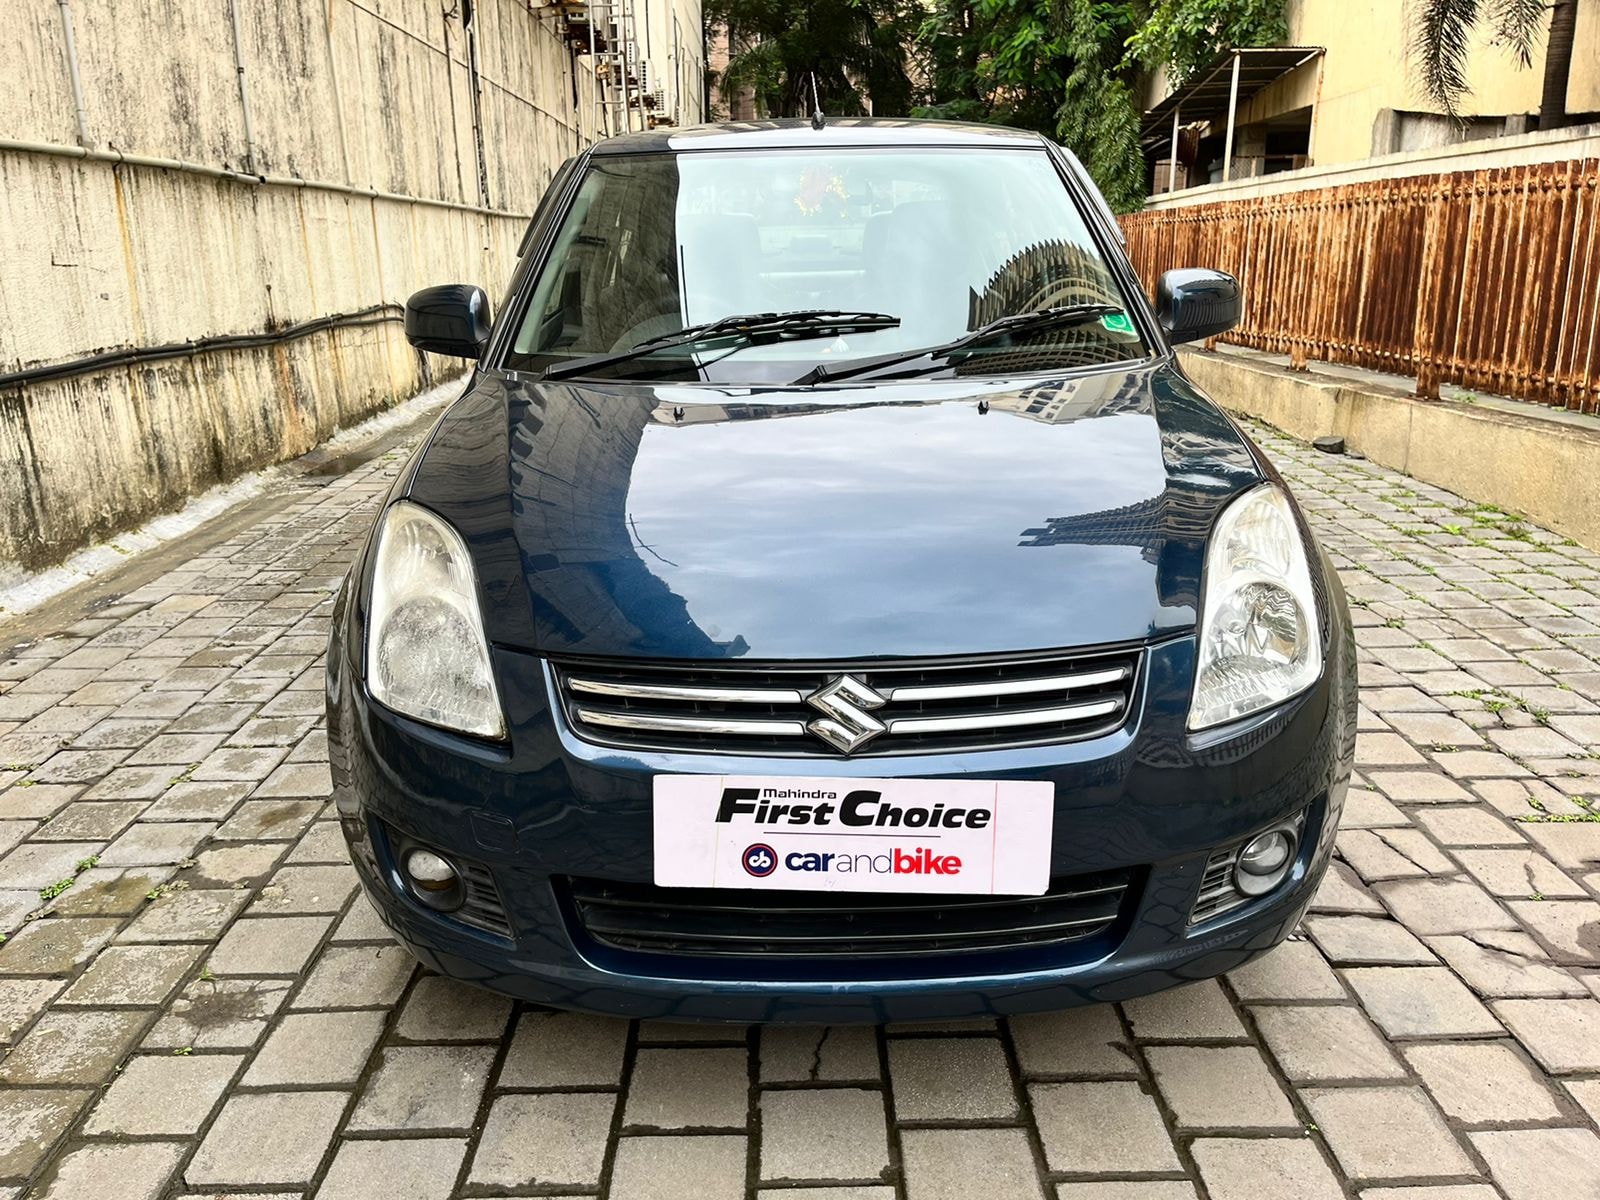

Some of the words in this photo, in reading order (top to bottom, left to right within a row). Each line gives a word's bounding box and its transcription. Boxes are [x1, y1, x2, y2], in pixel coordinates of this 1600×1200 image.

[763, 788, 837, 799] Mahindra
[714, 787, 836, 826] First
[838, 789, 992, 829] Choice
